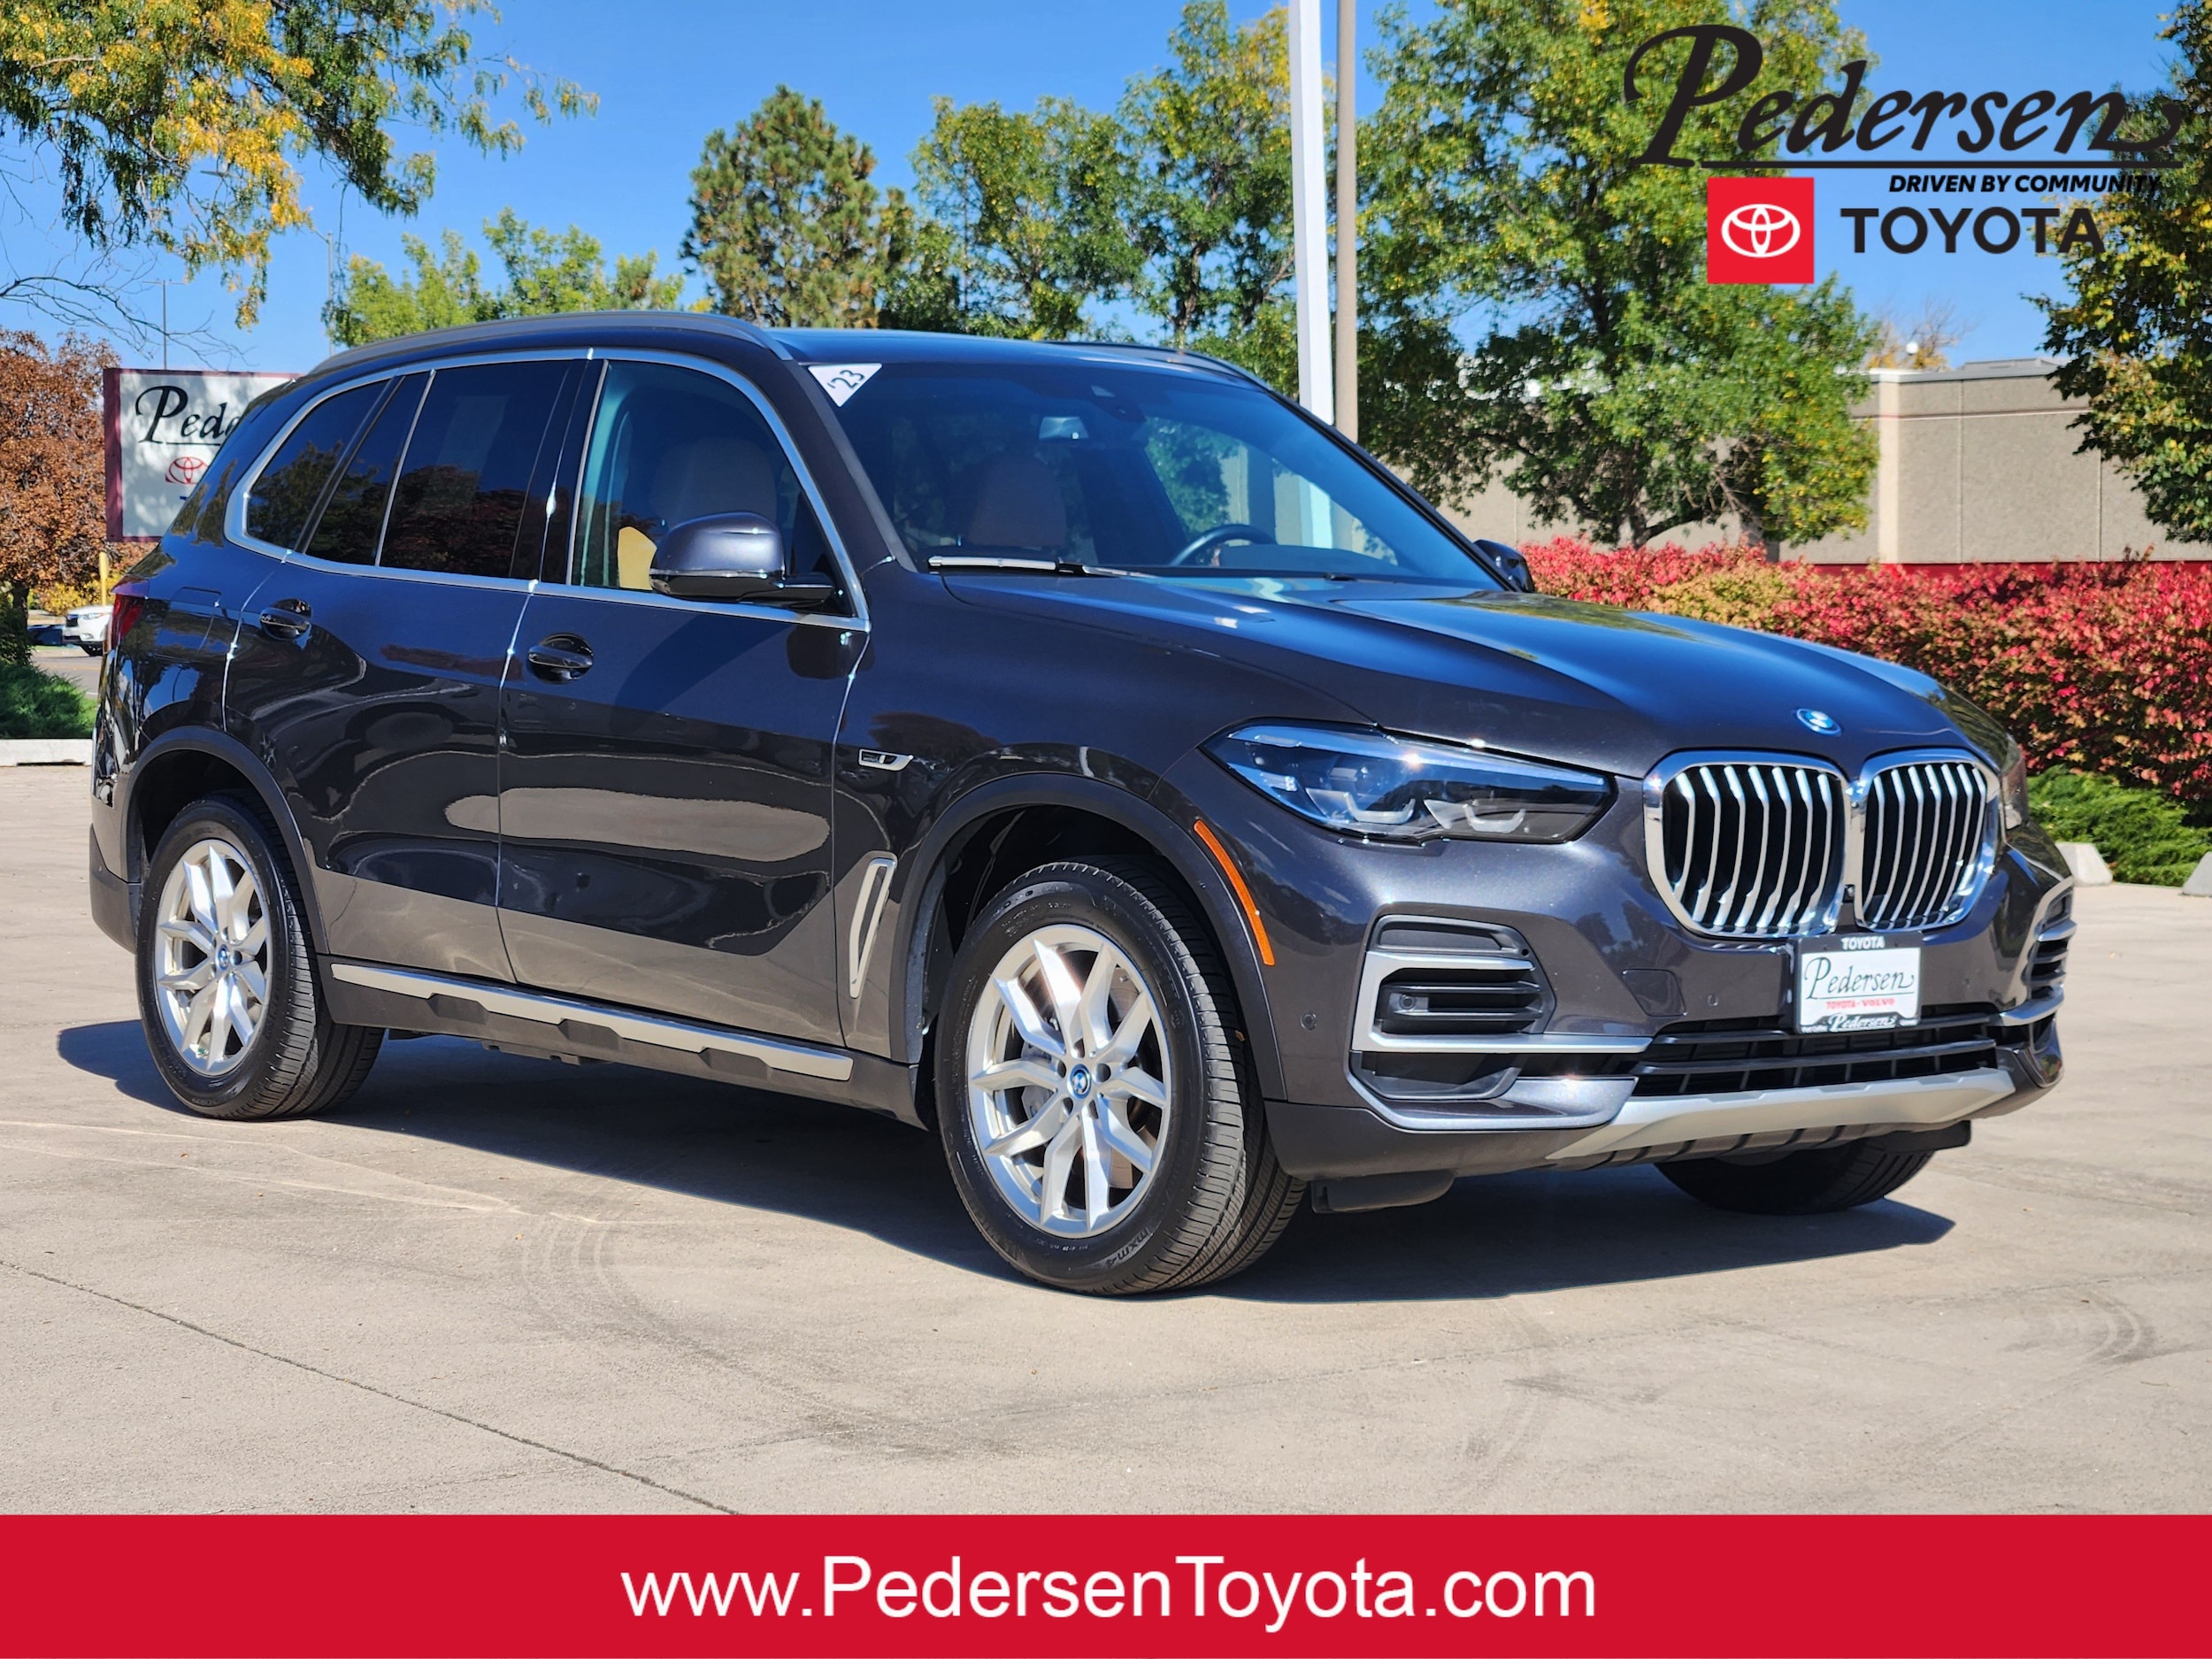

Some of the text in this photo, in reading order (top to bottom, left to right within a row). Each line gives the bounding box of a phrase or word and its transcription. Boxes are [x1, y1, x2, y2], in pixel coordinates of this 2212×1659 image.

[1840, 936, 1886, 950] TOYOTA
[1804, 956, 1915, 1000] Pedersen
[1825, 997, 1896, 1010] TOYOTA VOLVO
[1827, 1012, 1898, 1033] Pedersen
